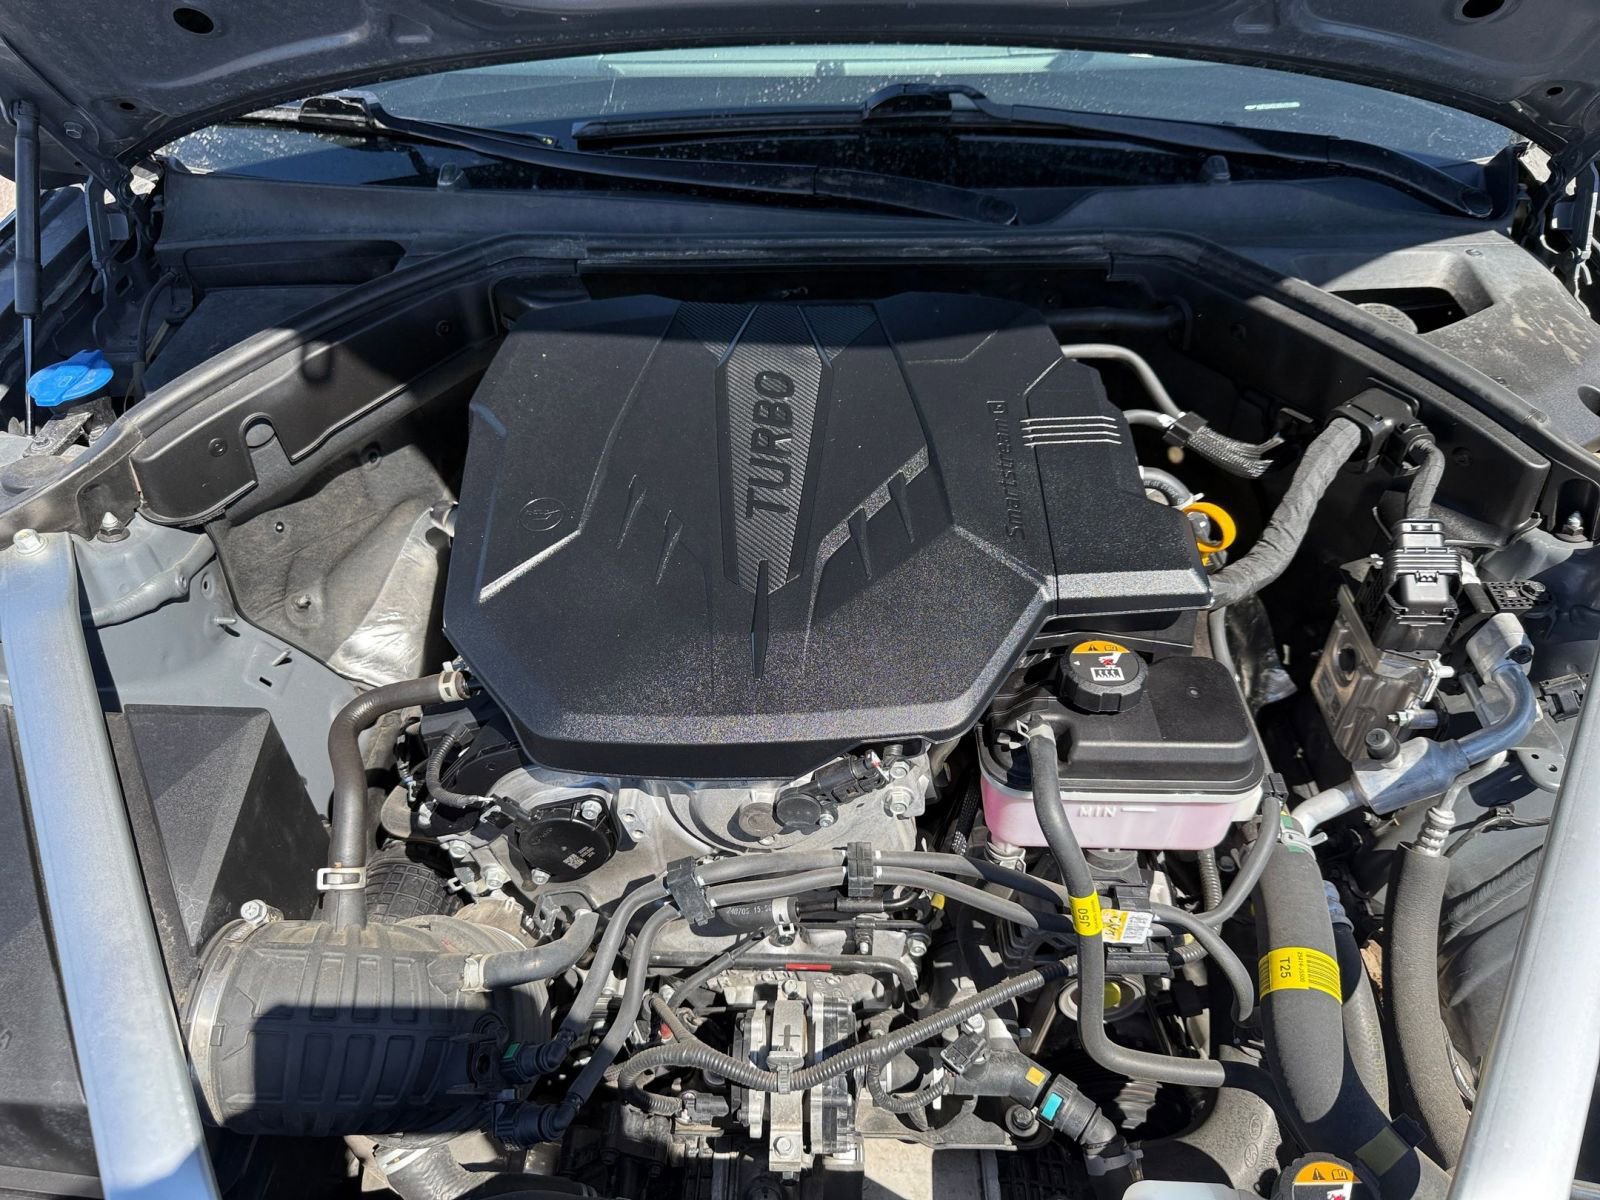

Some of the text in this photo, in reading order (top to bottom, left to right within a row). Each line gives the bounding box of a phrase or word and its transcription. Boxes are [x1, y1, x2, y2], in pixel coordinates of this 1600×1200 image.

[745, 370, 794, 519] TURBO
[995, 418, 1026, 541] Smartstream
[1077, 805, 1118, 818] MIN
[1077, 908, 1091, 928] J50
[1280, 957, 1291, 979] T25
